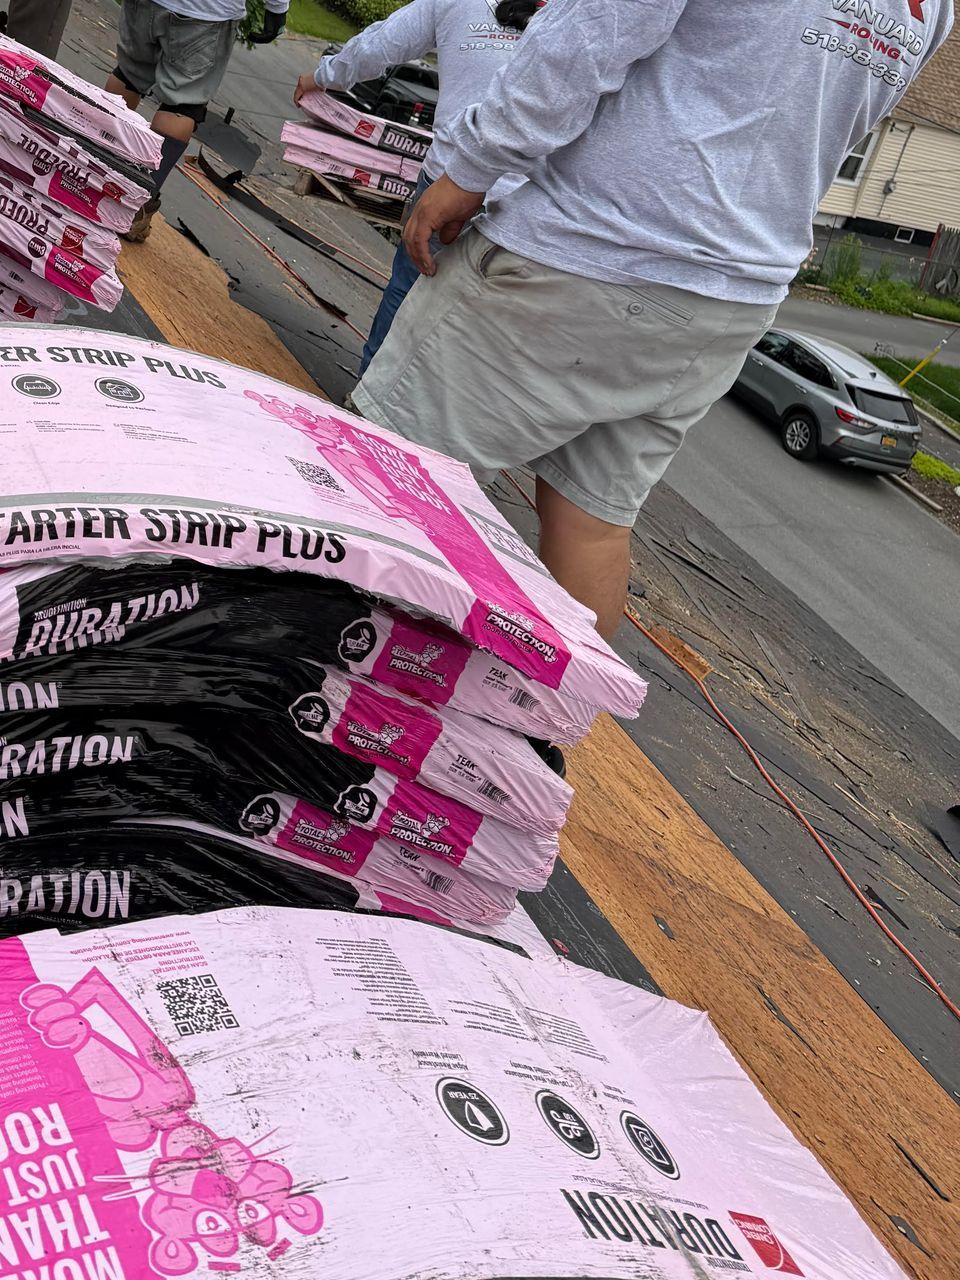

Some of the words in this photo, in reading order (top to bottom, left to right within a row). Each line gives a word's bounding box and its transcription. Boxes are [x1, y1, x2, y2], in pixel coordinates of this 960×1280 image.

[469, 23, 517, 34] VANG
[850, 23, 900, 60] ROING
[384, 132, 430, 157] DURAT
[46, 346, 136, 368] STRIP
[143, 358, 227, 390] PLUS
[143, 509, 247, 549] STRIP
[256, 520, 347, 563] PLUS
[26, 582, 200, 651] DURATION
[34, 597, 87, 621] TRUDEFINITION
[487, 613, 553, 656] PROTECTION
[390, 659, 443, 683] PROTECTION
[489, 667, 509, 681] TEAK
[456, 754, 478, 770] TEAK
[297, 825, 325, 840] TOTAL
[391, 828, 452, 854] PROTECTION
[292, 834, 350, 860] PROTECTION
[399, 846, 421, 862] TEAK
[158, 955, 204, 966] INSTRUCTIONS
[151, 966, 176, 974] INSTALL
[451, 1062, 469, 1071] Algae
[447, 1091, 468, 1099] YEAR
[468, 1092, 479, 1100] 25
[2, 1147, 86, 1207] JUST
[560, 1188, 744, 1261] DURATION
[733, 1219, 771, 1234] CORNING
[743, 1228, 775, 1245] OWENS
[704, 1256, 752, 1272] TRUDEFINITION
